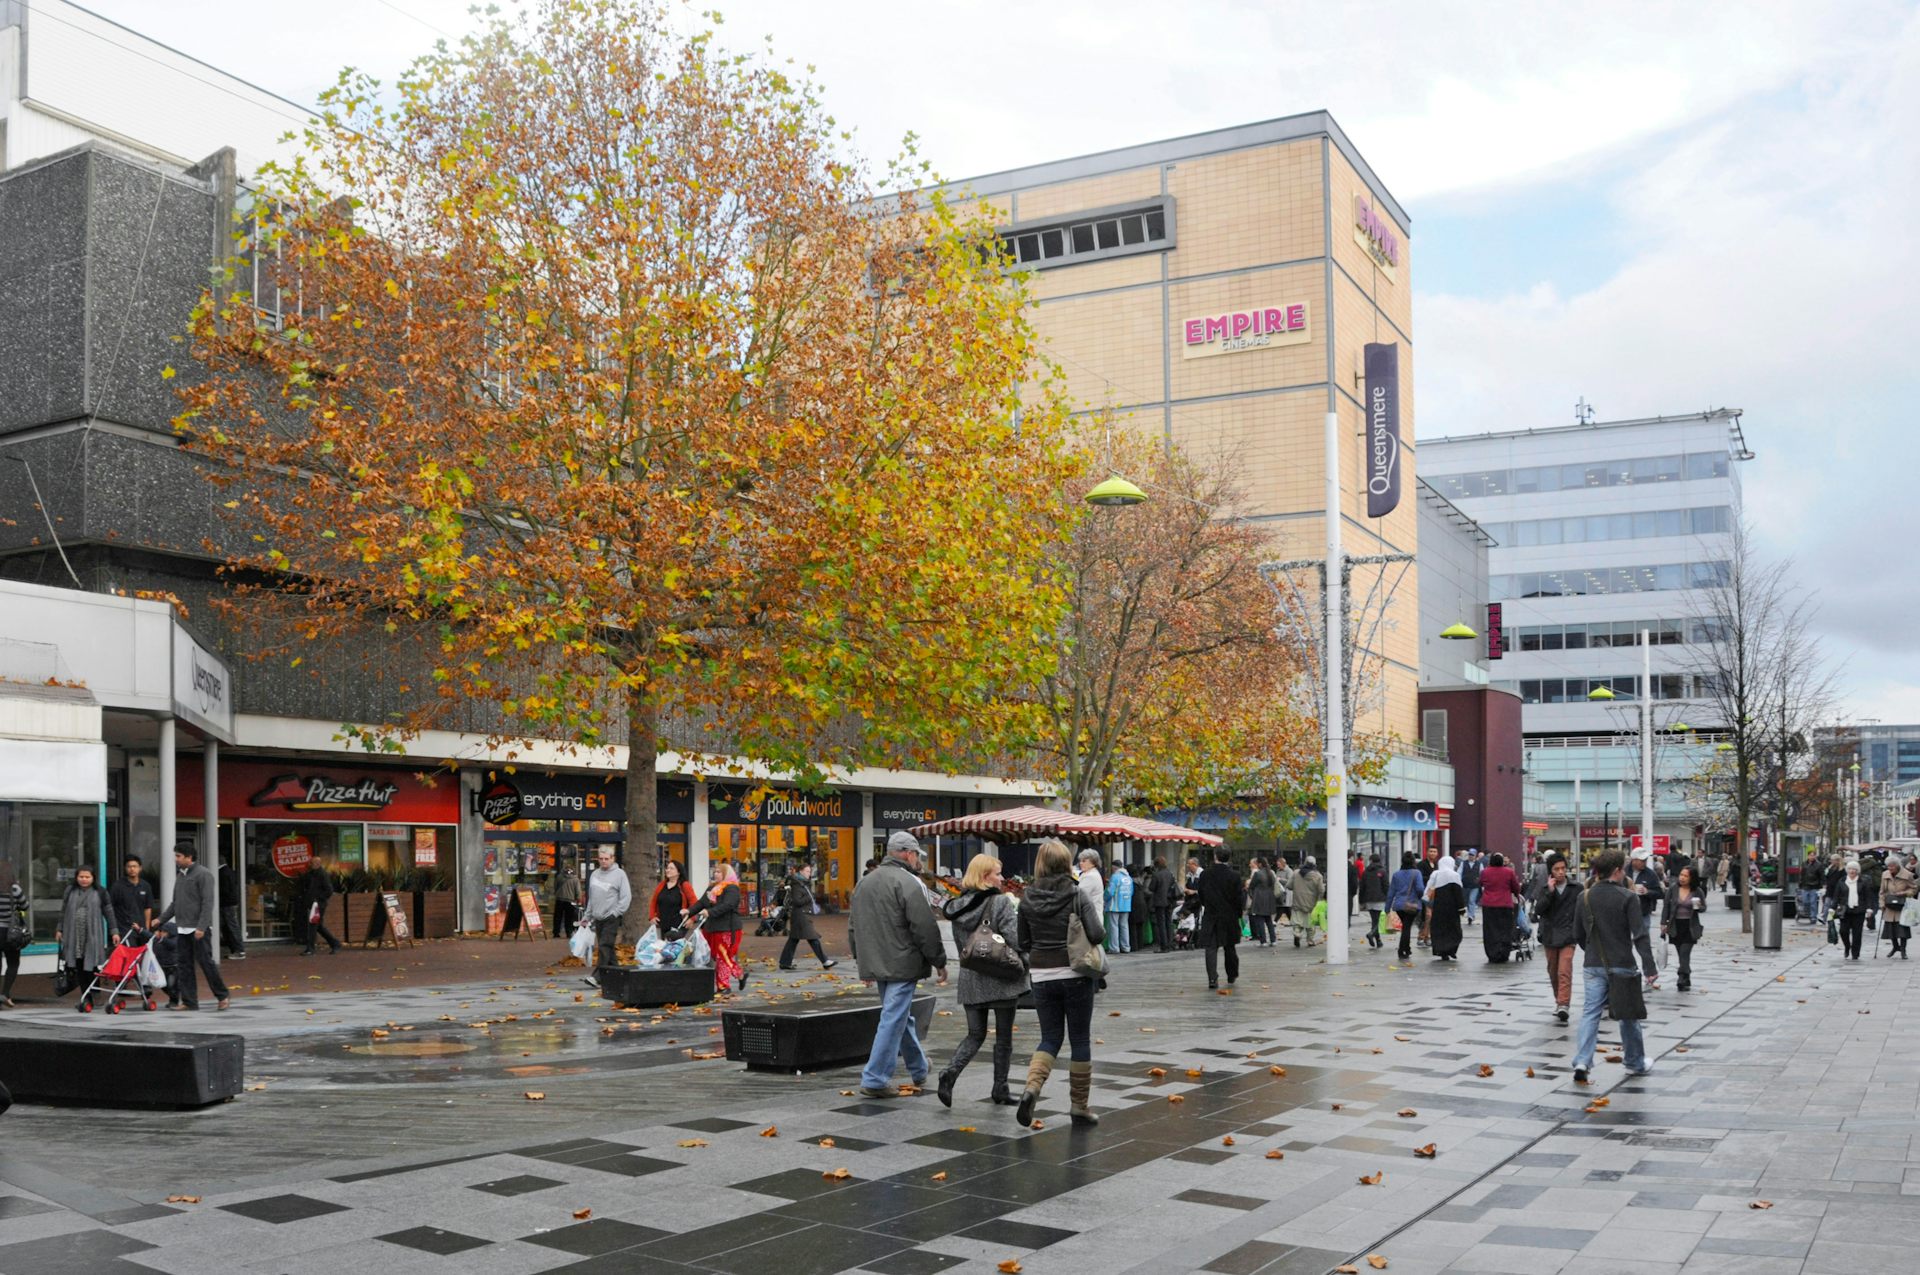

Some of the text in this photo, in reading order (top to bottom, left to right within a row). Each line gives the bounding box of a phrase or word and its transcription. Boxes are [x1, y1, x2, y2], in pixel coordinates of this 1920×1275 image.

[1185, 304, 1305, 345] EMPIRE
[1221, 336, 1271, 351] CINEMAS
[1369, 386, 1394, 494] Queensmere
[191, 646, 222, 710] Queensmere
[306, 779, 398, 802] Pizza Hut
[483, 796, 518, 815] Pizza
[523, 792, 607, 811] erything £1
[767, 795, 842, 820] poundworld
[490, 805, 514, 819] Hut
[883, 809, 937, 822] everything £1
[1414, 809, 1432, 825] O2
[368, 828, 385, 836] TAKE
